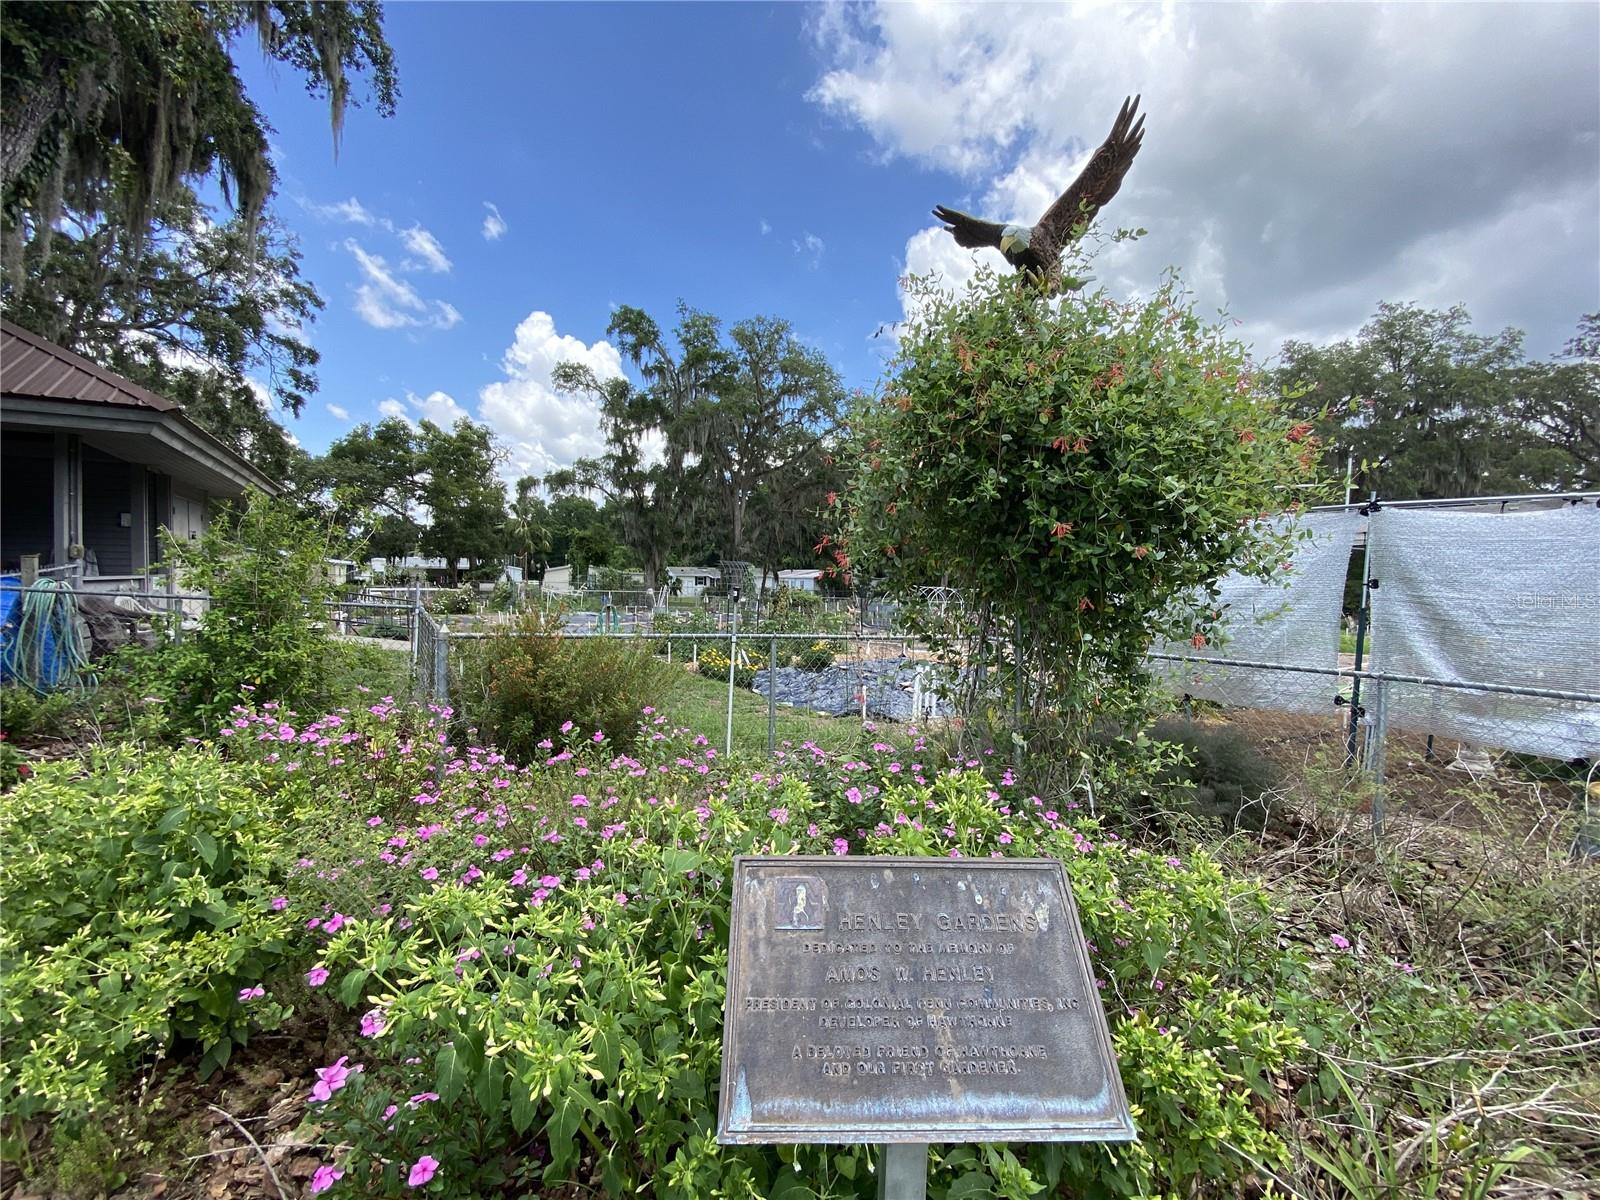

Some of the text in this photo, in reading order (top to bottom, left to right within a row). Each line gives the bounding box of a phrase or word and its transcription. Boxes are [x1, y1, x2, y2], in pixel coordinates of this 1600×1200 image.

[838, 912, 1040, 933] HENLEY GARDENS
[802, 942, 1014, 955] DEDICATED TO THE MEMORY OF
[826, 966, 995, 984] AMOS W. HENLEY
[745, 997, 817, 1011] PRESIDENT
[823, 998, 841, 1011] OF
[846, 998, 912, 1011] COLONIAL
[918, 998, 954, 1011] PENN
[958, 997, 1054, 1012] COMMUNITIES,
[819, 1014, 1012, 1029] DEVELOPER OF HAWTHORNE
[792, 1044, 1048, 1059] A BELOVED FRIEND OF HAWTHORNE
[822, 1060, 1021, 1077] AND OUR FIRST GARDENER.
